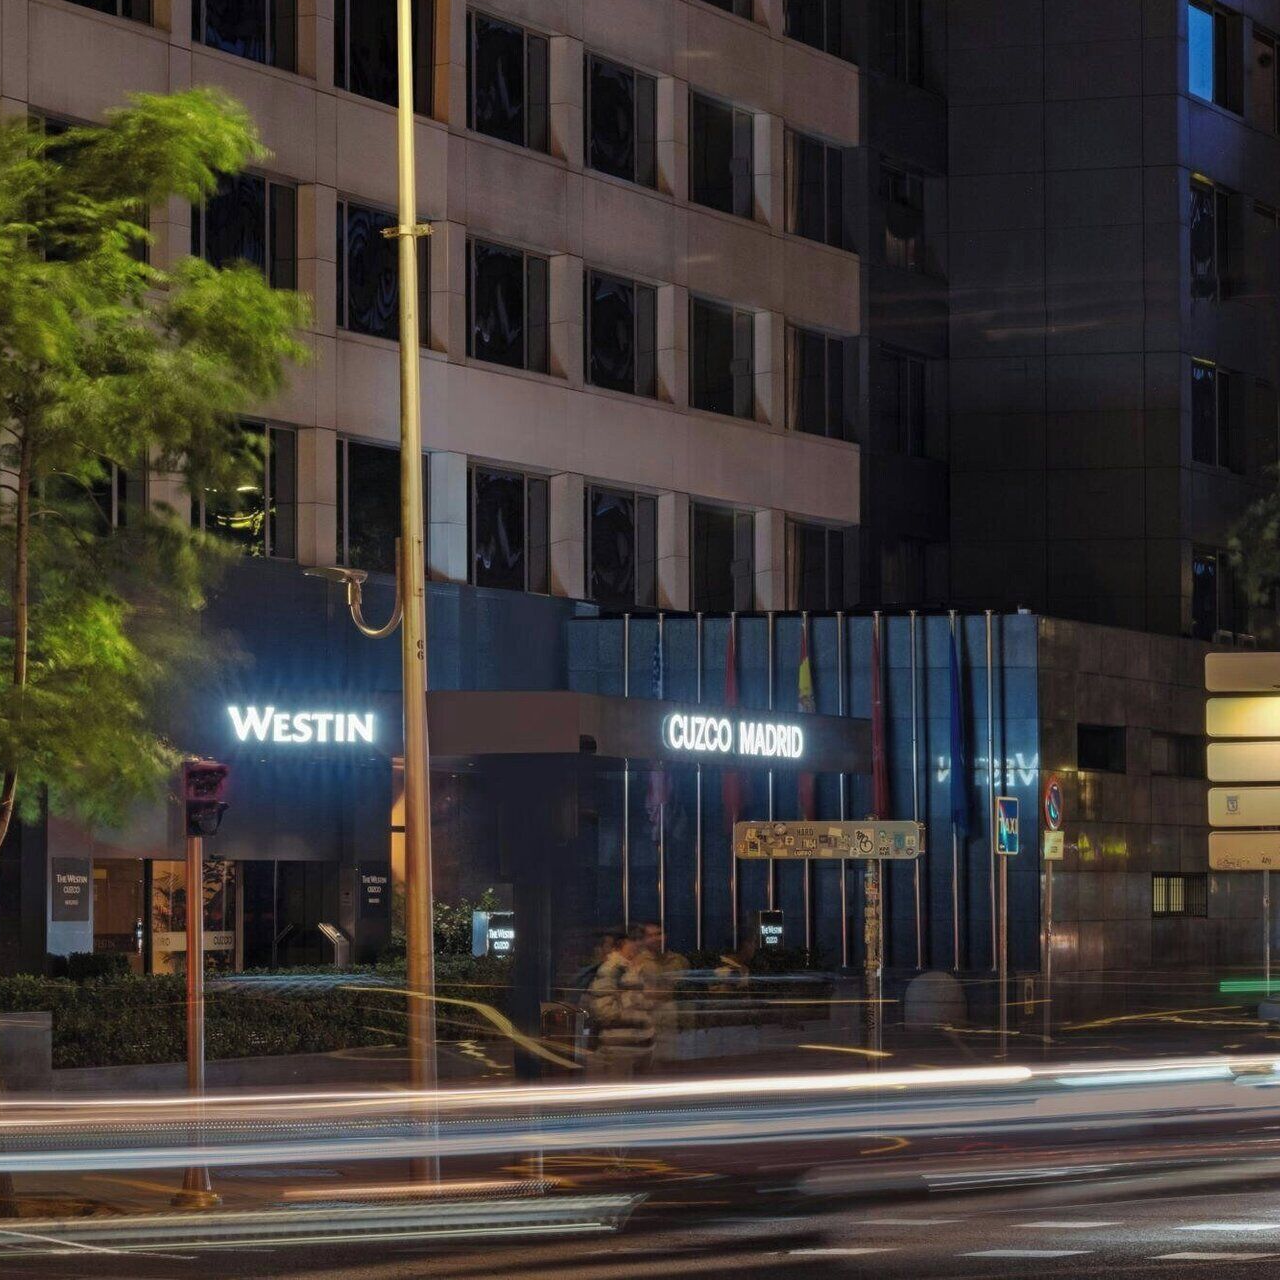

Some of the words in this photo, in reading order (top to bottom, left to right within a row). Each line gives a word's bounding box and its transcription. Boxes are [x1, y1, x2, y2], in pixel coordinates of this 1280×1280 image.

[227, 705, 375, 744] WESTIN
[669, 713, 733, 752] CUZCO
[739, 721, 804, 759] MADRID
[1000, 817, 1018, 834] TAXI
